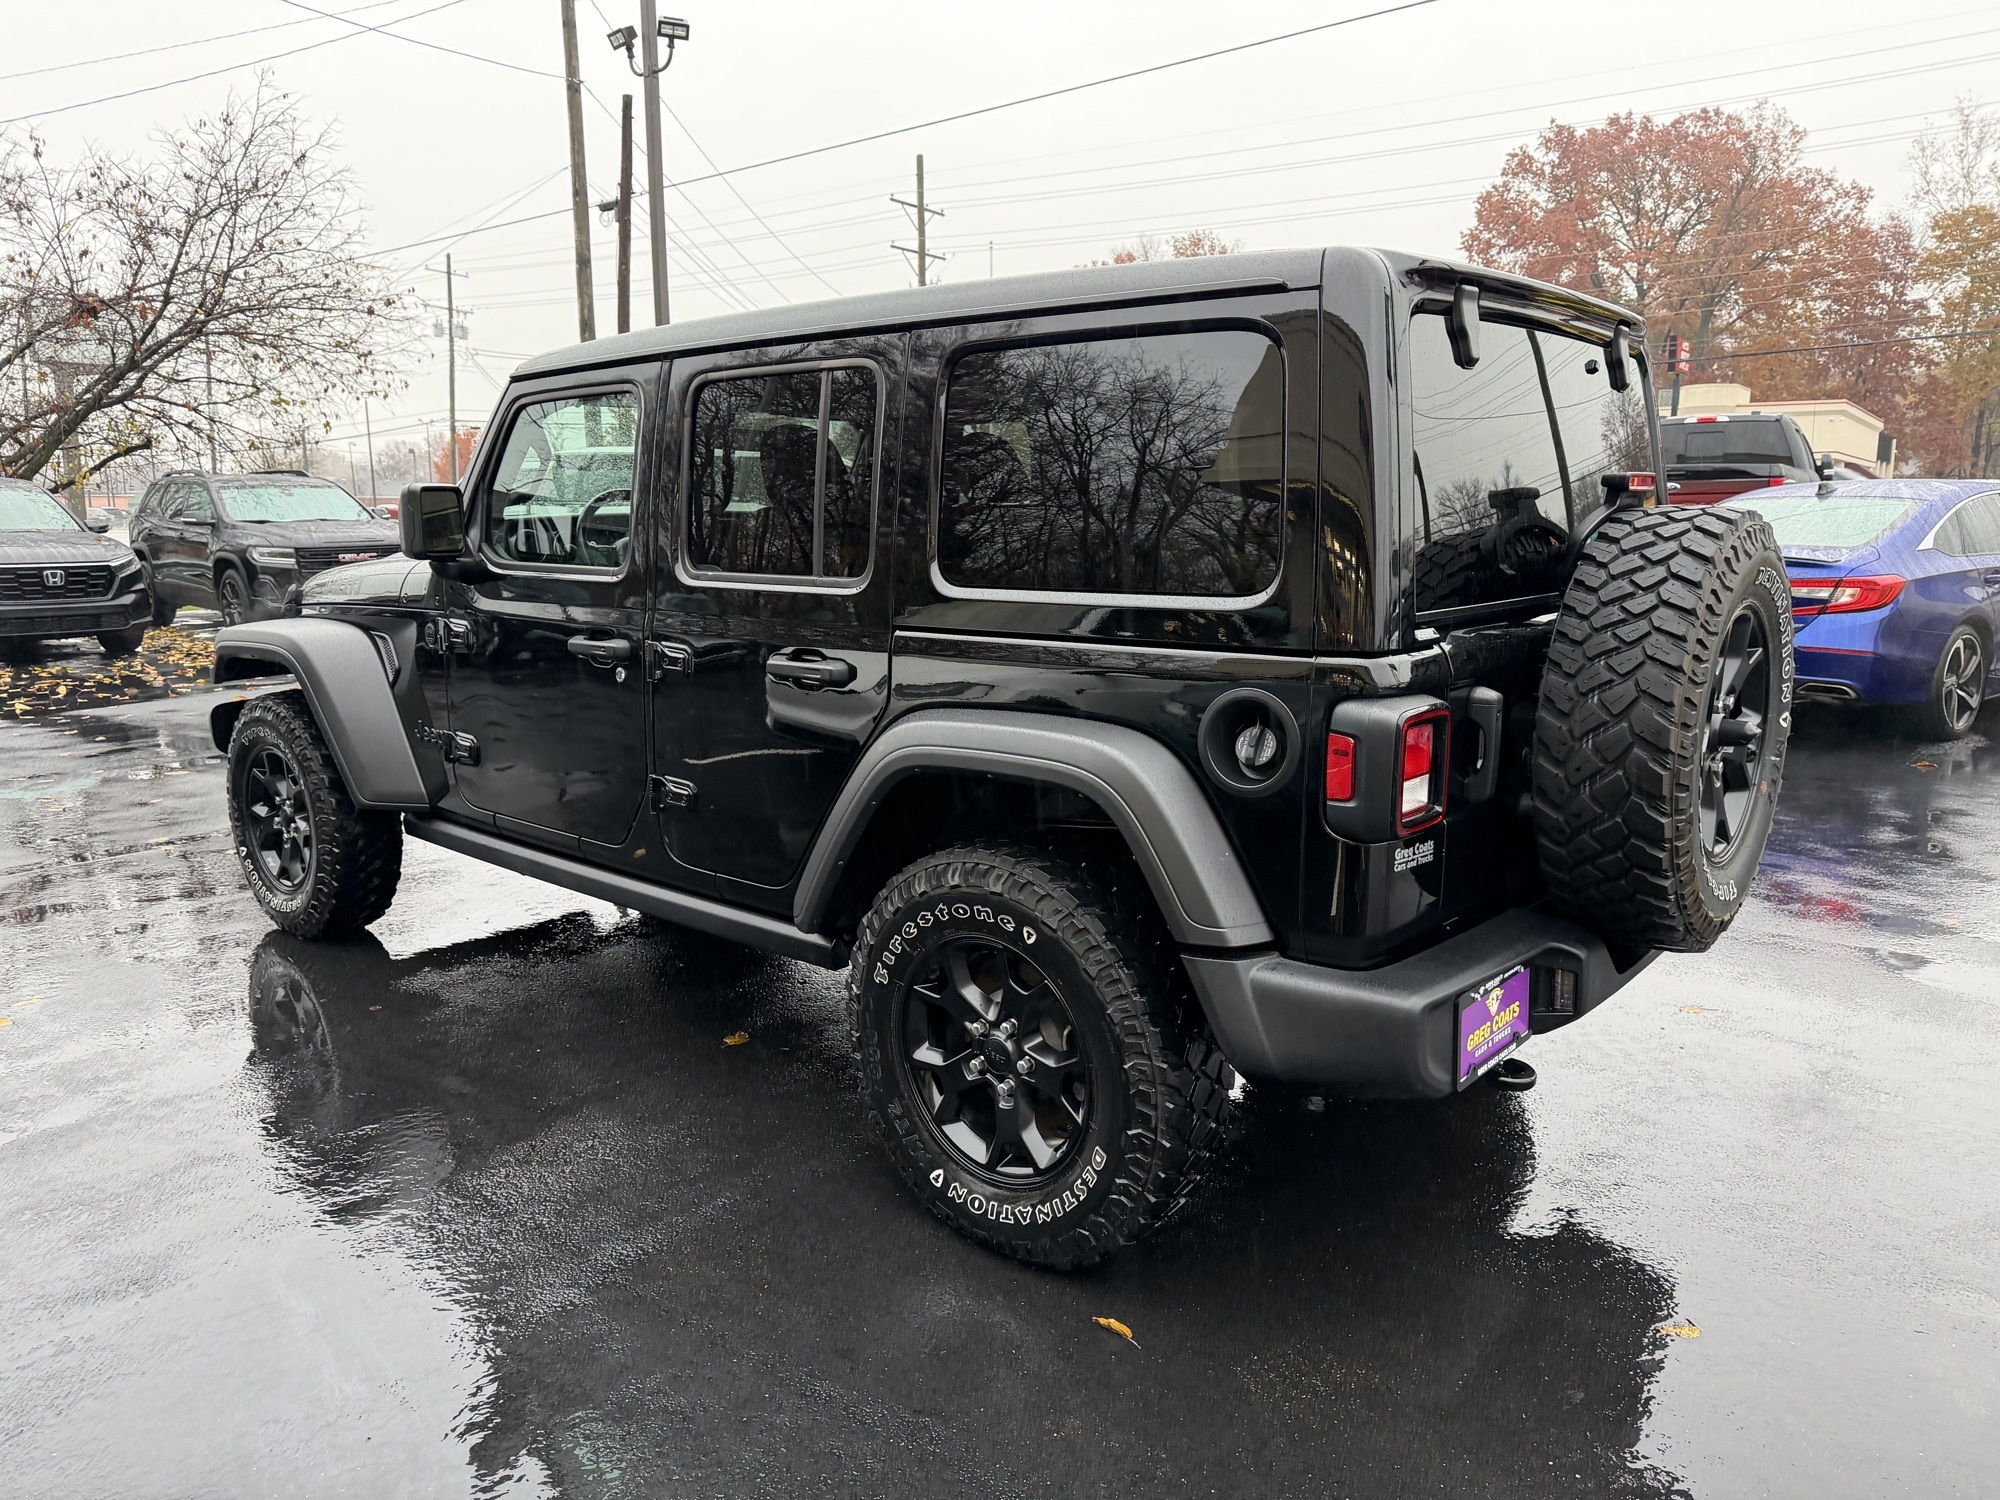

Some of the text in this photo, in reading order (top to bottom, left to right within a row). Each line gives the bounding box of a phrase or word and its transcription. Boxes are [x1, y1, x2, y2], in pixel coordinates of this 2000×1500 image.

[338, 552, 377, 562] GMC
[1755, 566, 1792, 703] DESTINATION
[1394, 854, 1433, 872] Cars and Trucks
[1395, 840, 1434, 860] Greg Coats
[244, 857, 303, 913] DESTINATION
[873, 902, 1016, 985] Firestone
[1467, 1001, 1520, 1052] GREG COATS
[1474, 1044, 1488, 1058] CARS
[1493, 1026, 1511, 1045] TRUCKS
[947, 1145, 1108, 1225] DESTINATION
